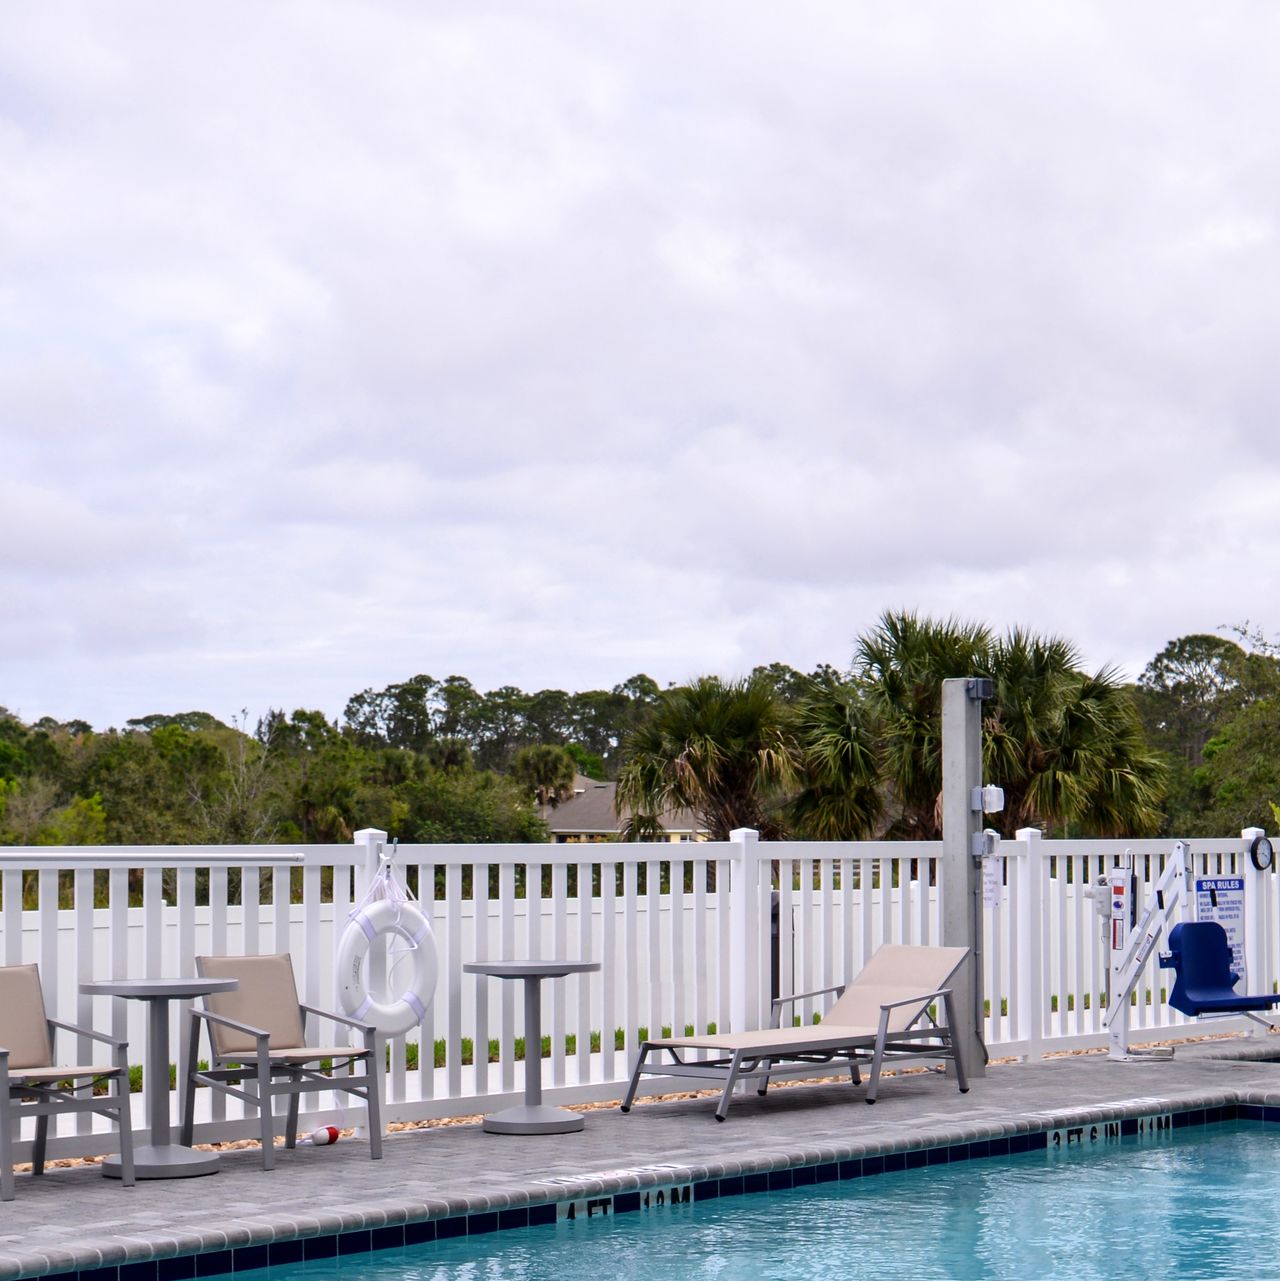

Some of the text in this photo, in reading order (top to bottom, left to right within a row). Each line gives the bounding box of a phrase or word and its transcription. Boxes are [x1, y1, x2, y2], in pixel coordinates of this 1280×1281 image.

[1202, 880, 1240, 890] SPA RULES
[1067, 1127, 1083, 1144] FT
[1104, 1122, 1119, 1138] IN
[587, 1198, 612, 1218] FT
[670, 1185, 691, 1205] M
